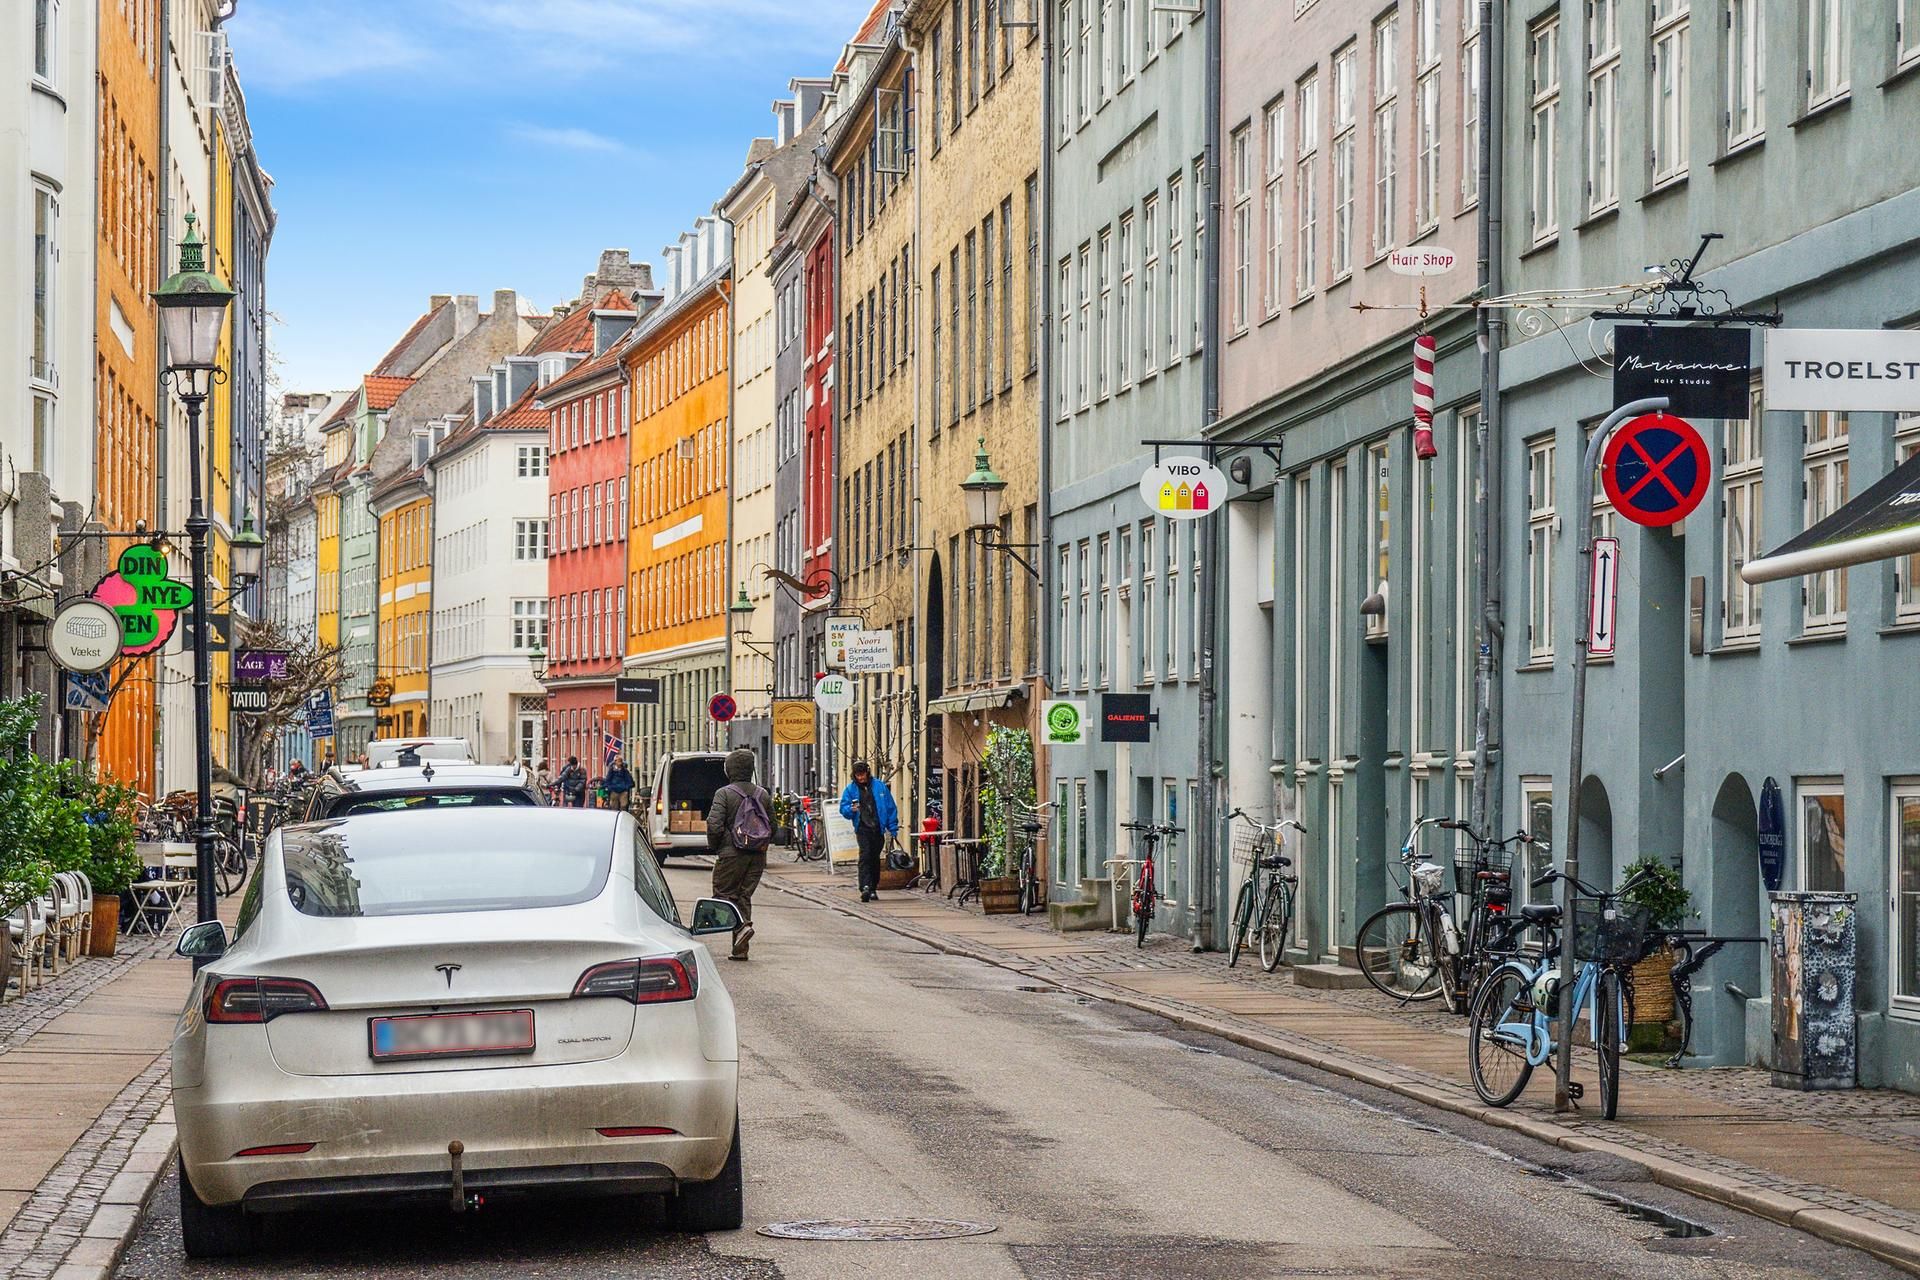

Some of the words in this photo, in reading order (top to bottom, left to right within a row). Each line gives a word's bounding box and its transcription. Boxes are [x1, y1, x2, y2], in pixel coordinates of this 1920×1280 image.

[1392, 253, 1418, 265] Hair
[1423, 253, 1453, 268] Shop
[1654, 377, 1674, 385] Hair
[1168, 465, 1201, 475] VIBO
[123, 556, 161, 576] DIN
[142, 585, 182, 605] NYE
[70, 646, 102, 657] Vækst
[849, 662, 891, 671] Reparation
[821, 680, 843, 695] ALLEZ
[231, 691, 267, 708] TATTOO
